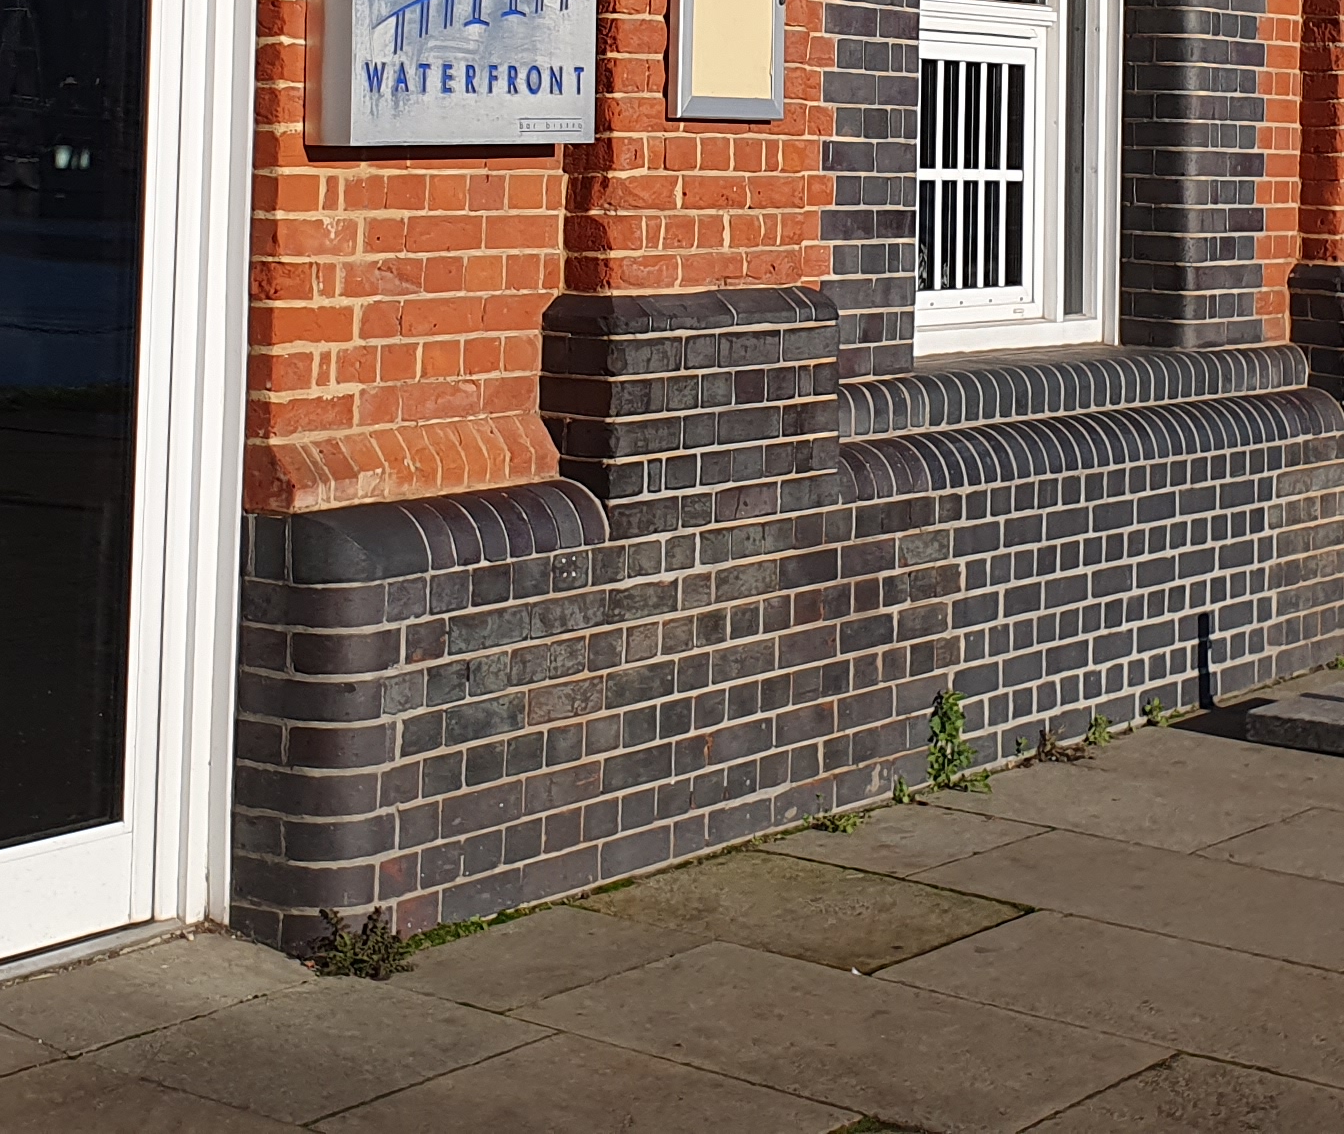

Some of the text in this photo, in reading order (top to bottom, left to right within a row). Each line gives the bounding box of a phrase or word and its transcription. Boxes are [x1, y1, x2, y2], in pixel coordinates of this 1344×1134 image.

[364, 61, 585, 96] WATERFRONT
[519, 121, 583, 130] bar bistro
